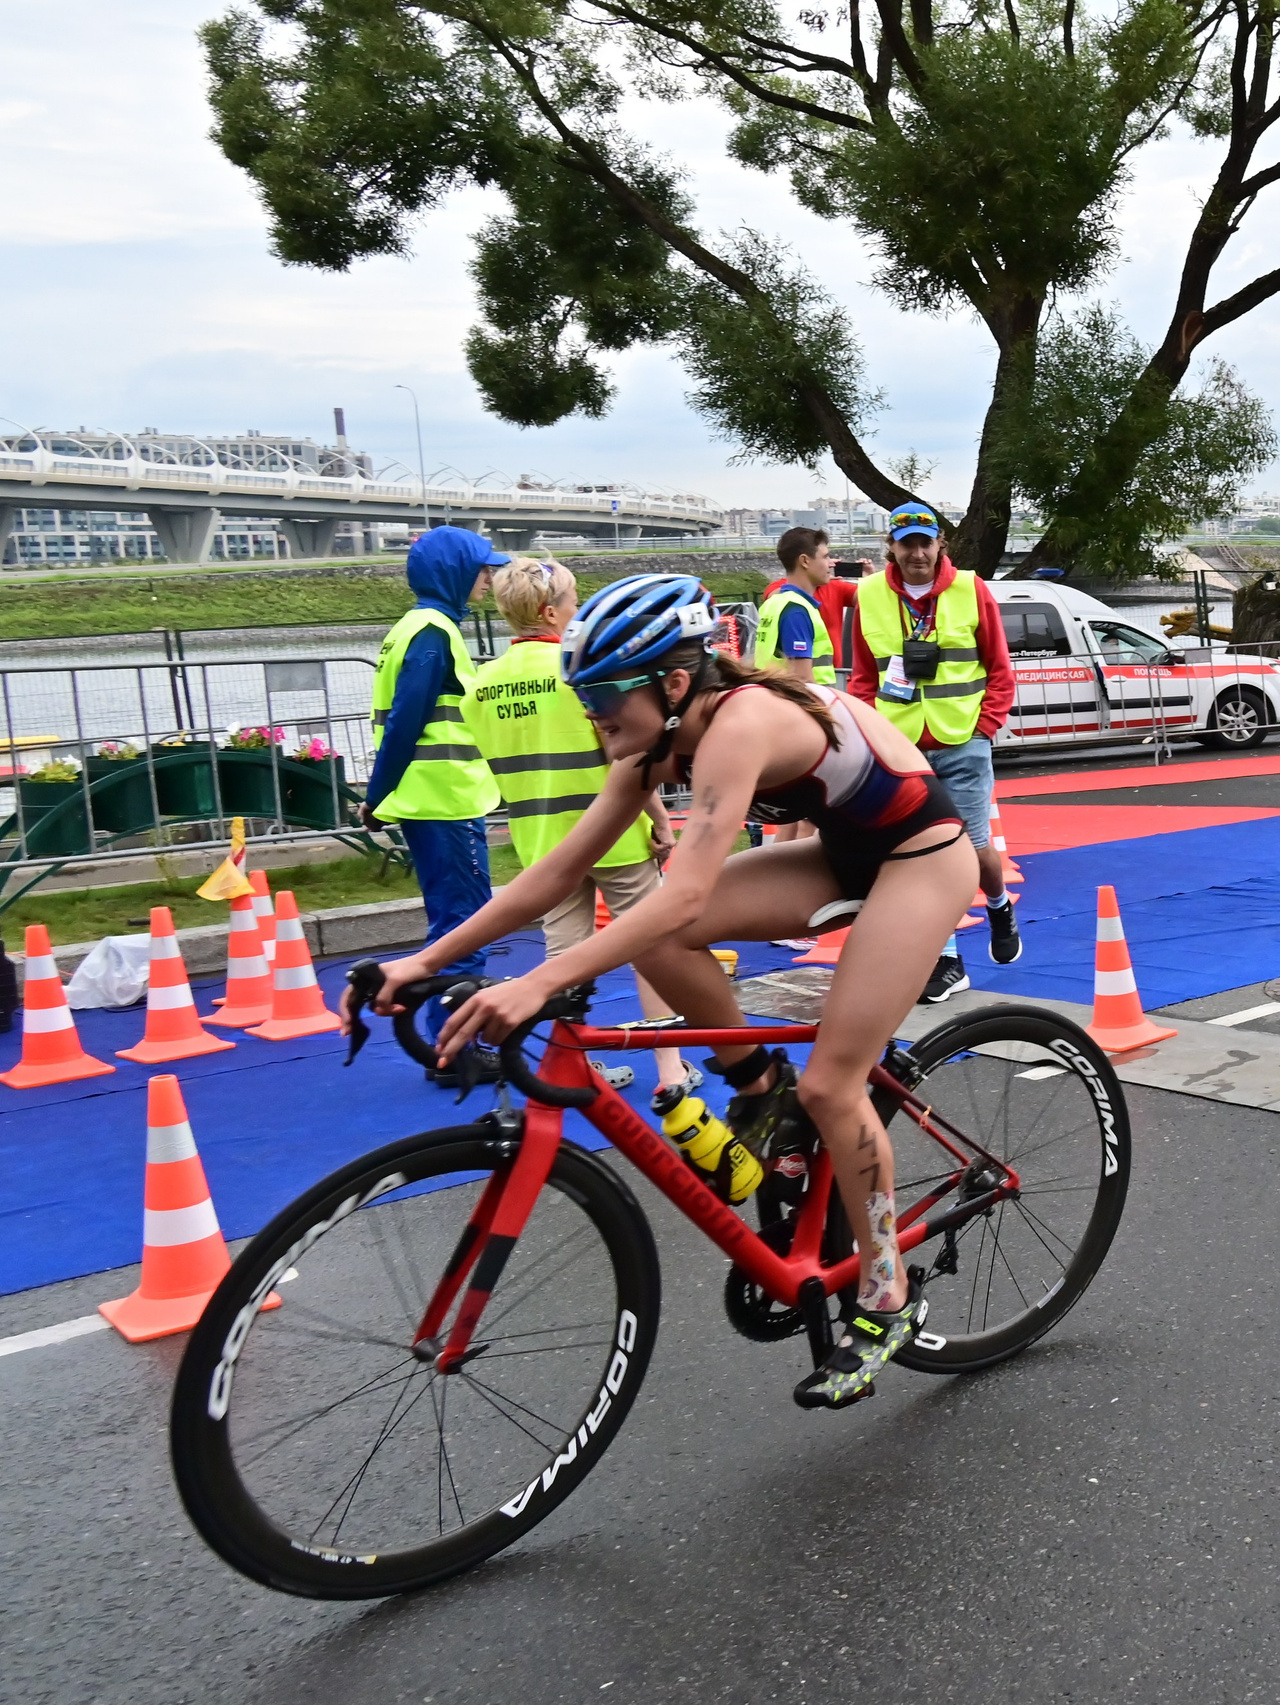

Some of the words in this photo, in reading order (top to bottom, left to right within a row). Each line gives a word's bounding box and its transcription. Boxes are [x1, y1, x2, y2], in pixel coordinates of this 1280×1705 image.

[476, 676, 556, 702] СПОРТИВНЫЙ
[1016, 671, 1085, 682] МЕДИЦИНСКАЯ
[497, 701, 537, 719] СУДЬЯ
[1048, 1038, 1119, 1177] CORIMA
[499, 1309, 638, 1518] CORIMA
